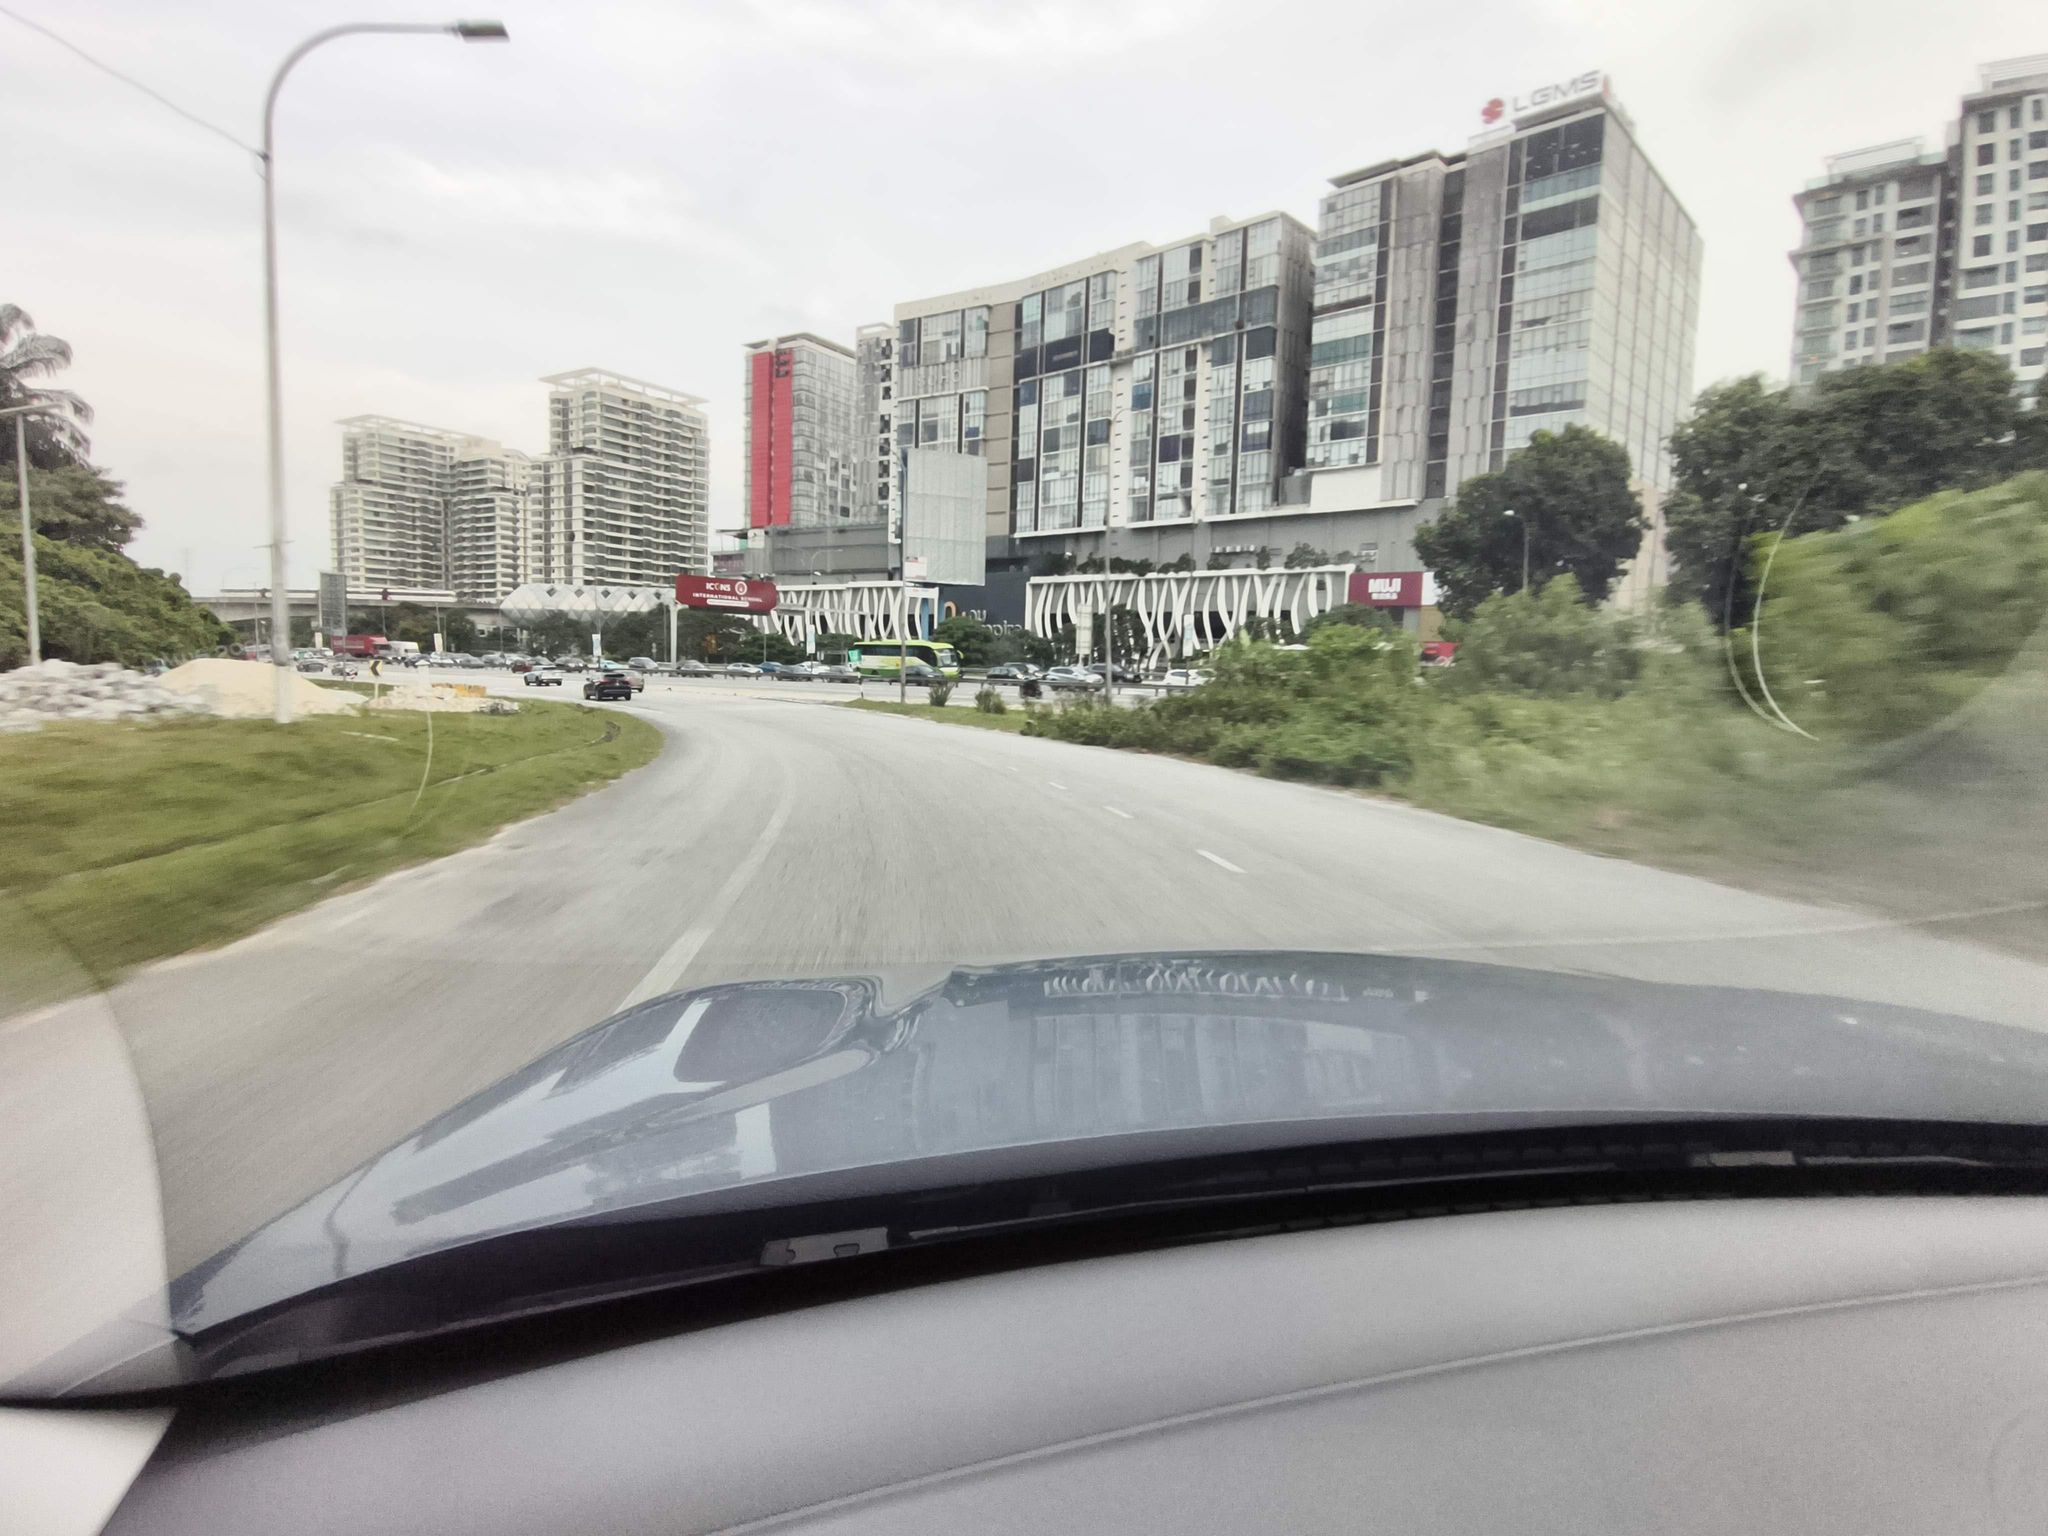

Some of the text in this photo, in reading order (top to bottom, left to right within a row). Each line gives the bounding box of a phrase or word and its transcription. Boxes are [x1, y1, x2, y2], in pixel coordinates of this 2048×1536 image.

[1512, 69, 1601, 112] LGMS
[705, 582, 731, 592] ICONS
[1368, 578, 1402, 593] MUJI
